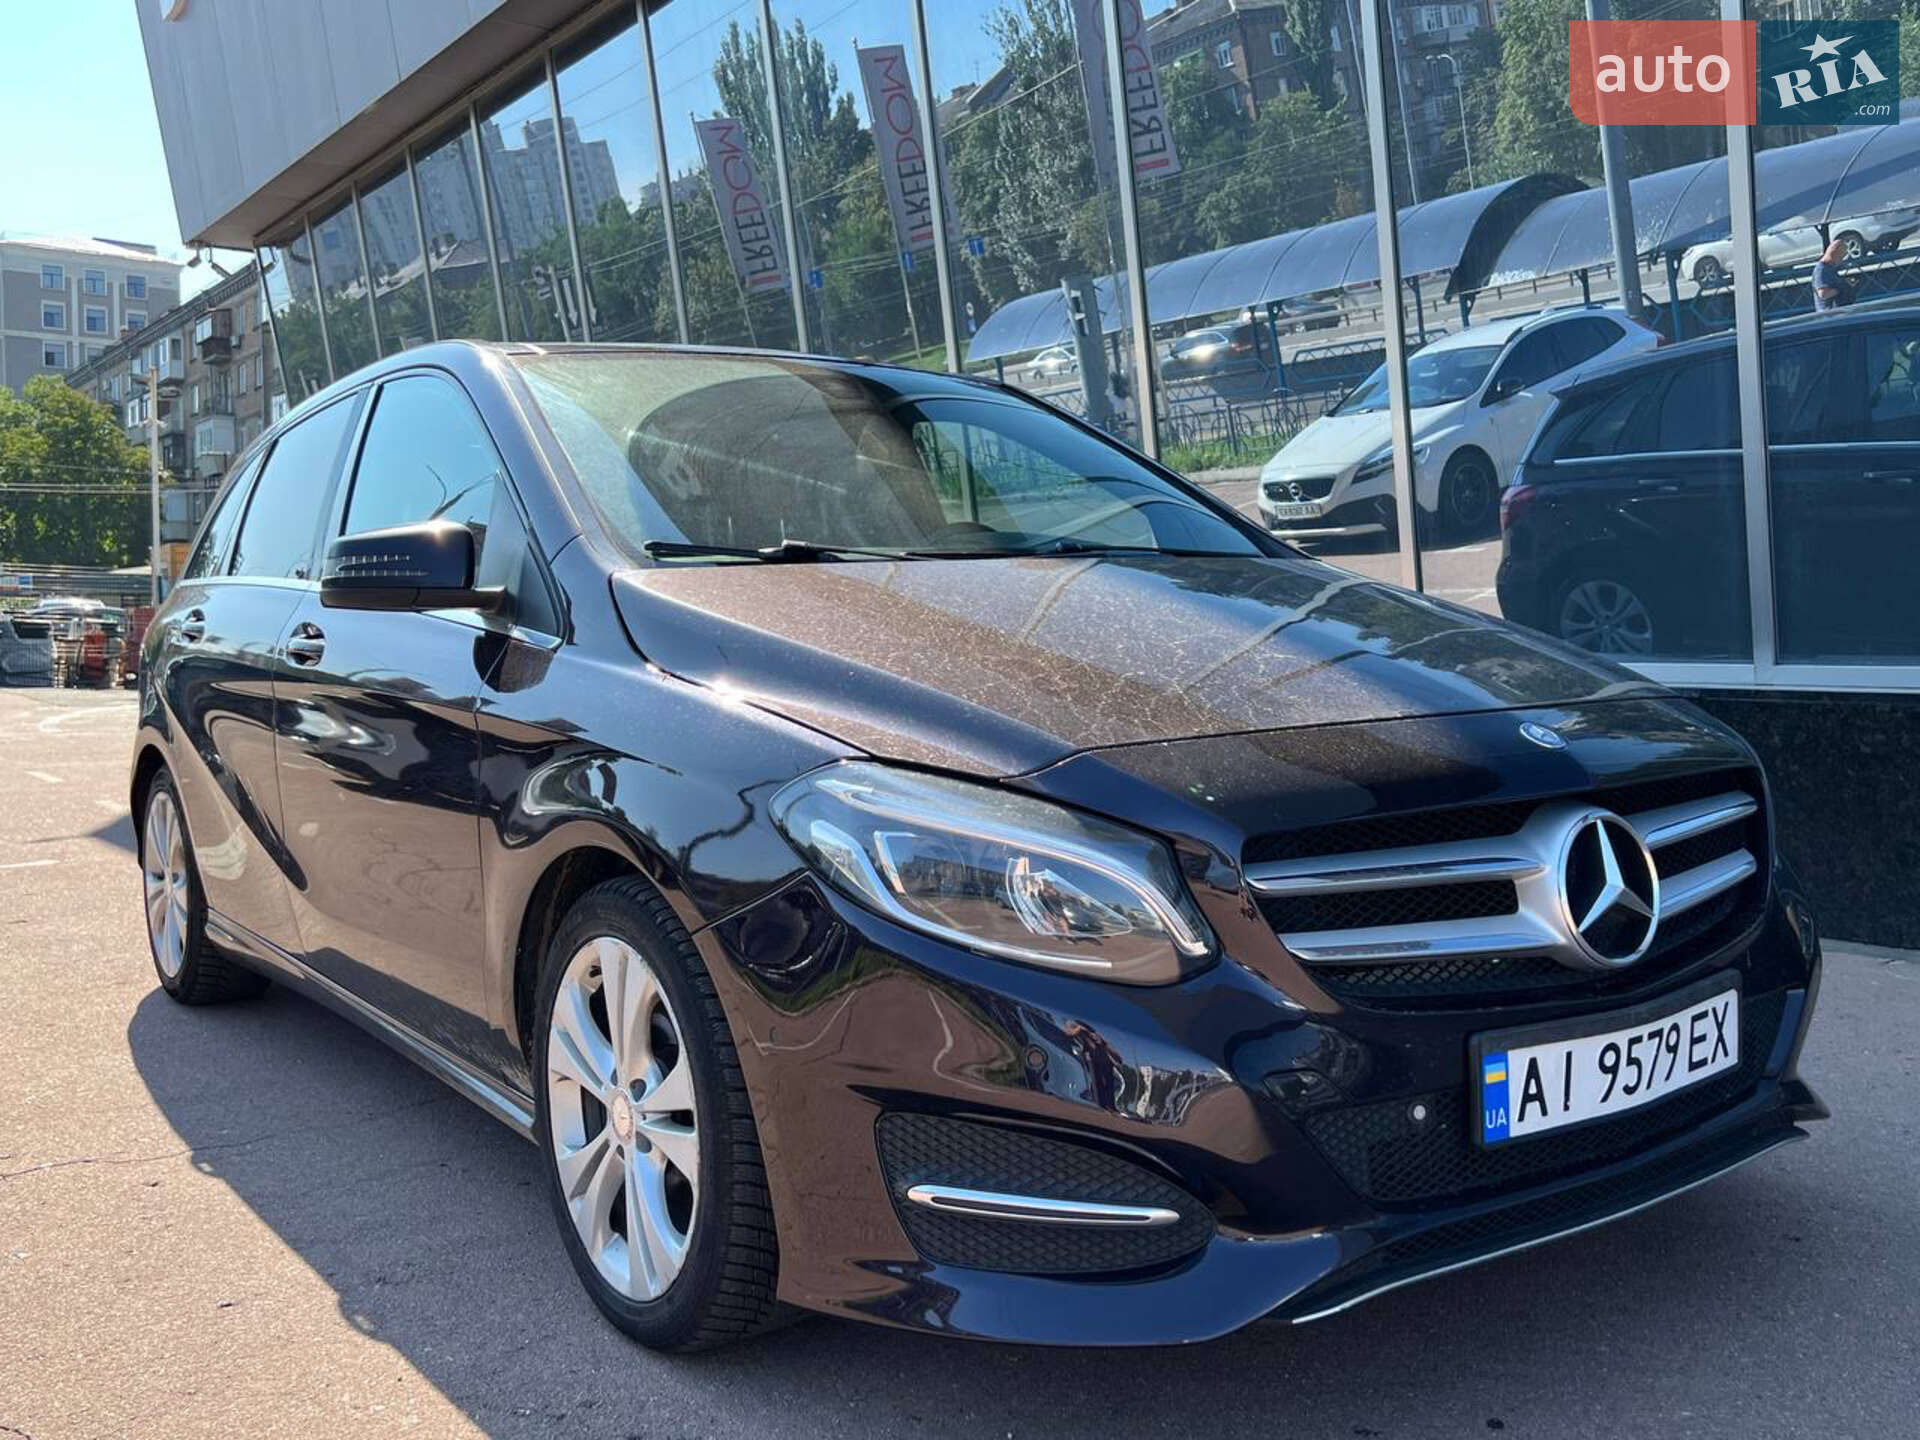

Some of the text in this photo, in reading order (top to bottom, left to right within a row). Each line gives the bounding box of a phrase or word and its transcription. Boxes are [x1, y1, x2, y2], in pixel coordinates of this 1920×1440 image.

[1517, 1001, 1729, 1123] AI 9579 EX
[1486, 1107, 1508, 1129] UA
